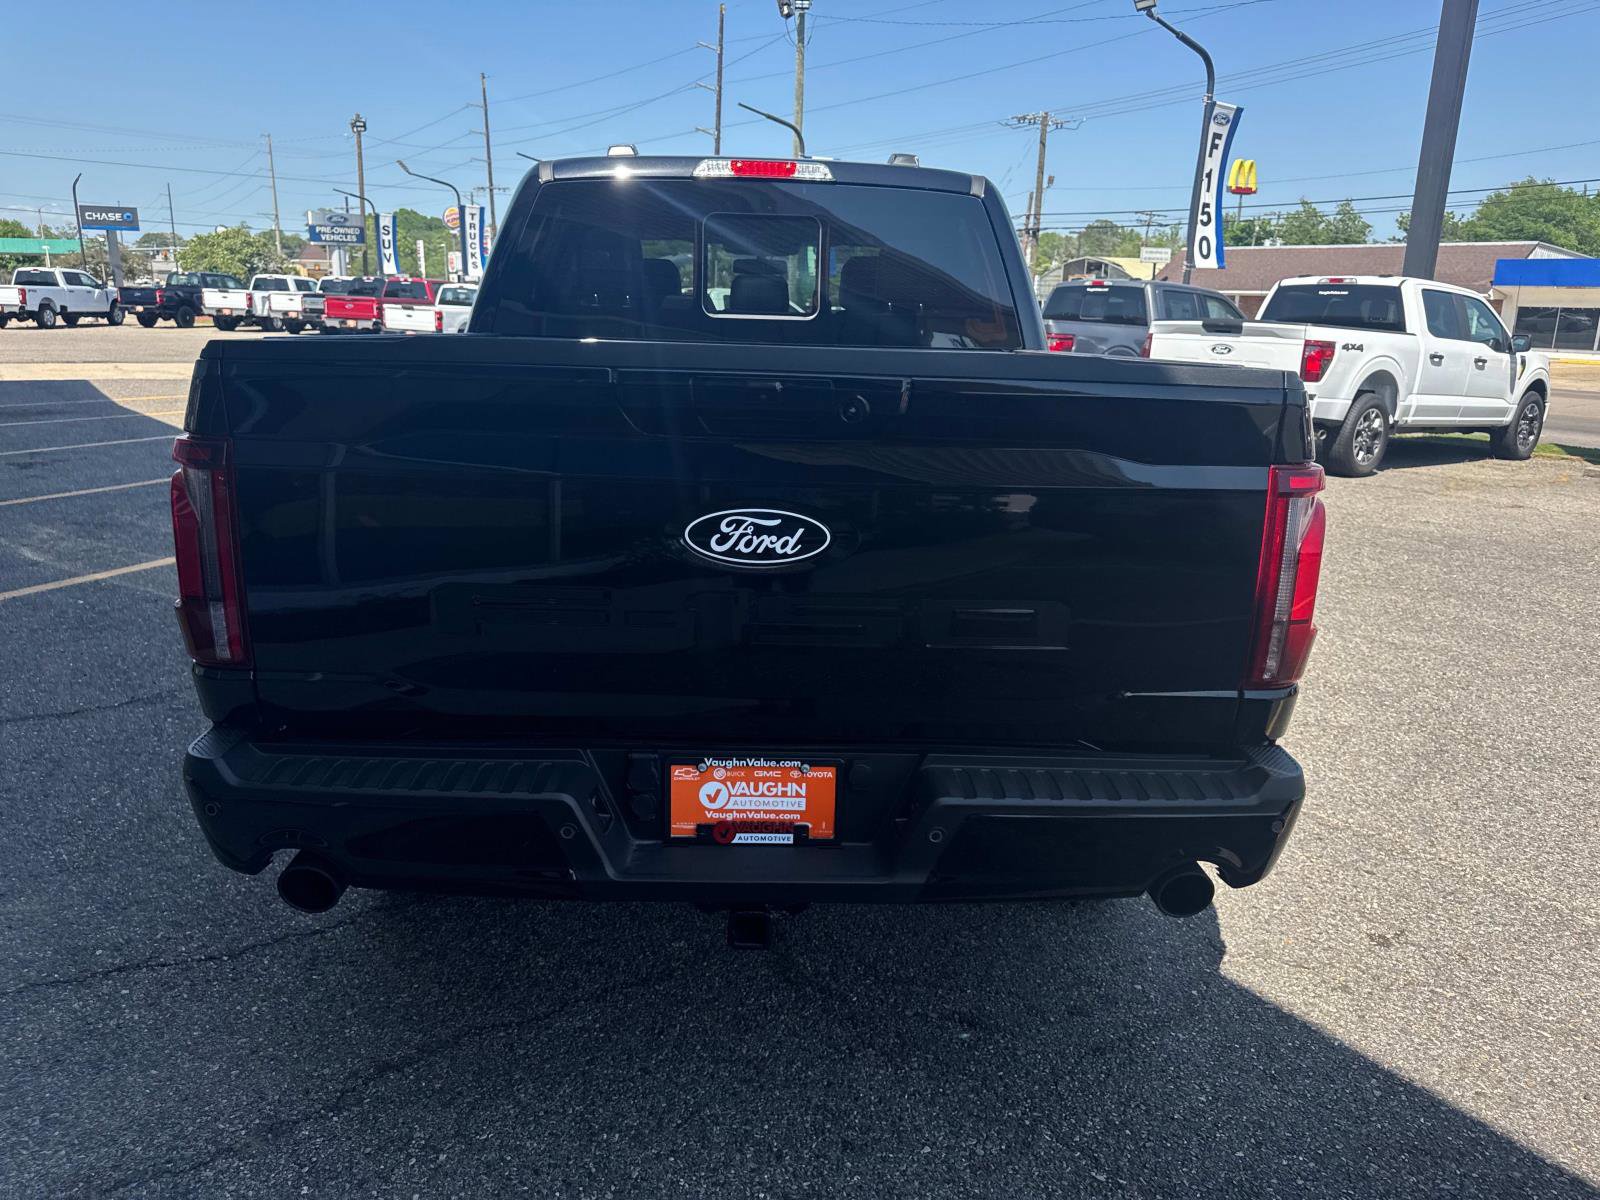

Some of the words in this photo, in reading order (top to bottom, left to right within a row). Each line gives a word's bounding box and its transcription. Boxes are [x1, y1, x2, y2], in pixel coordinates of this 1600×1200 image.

[85, 212, 123, 221] CHASE
[316, 226, 360, 235] PRE-OWNED
[320, 234, 357, 242] VEHICLES
[469, 213, 479, 270] TRUCKS
[382, 225, 392, 263] SUV
[710, 515, 805, 555] Ford
[704, 757, 801, 769] VaughnValue.com
[727, 781, 806, 797] VAUGHN
[732, 799, 804, 808] AUTOMOTIVE
[705, 810, 800, 821] VaughnValue.com
